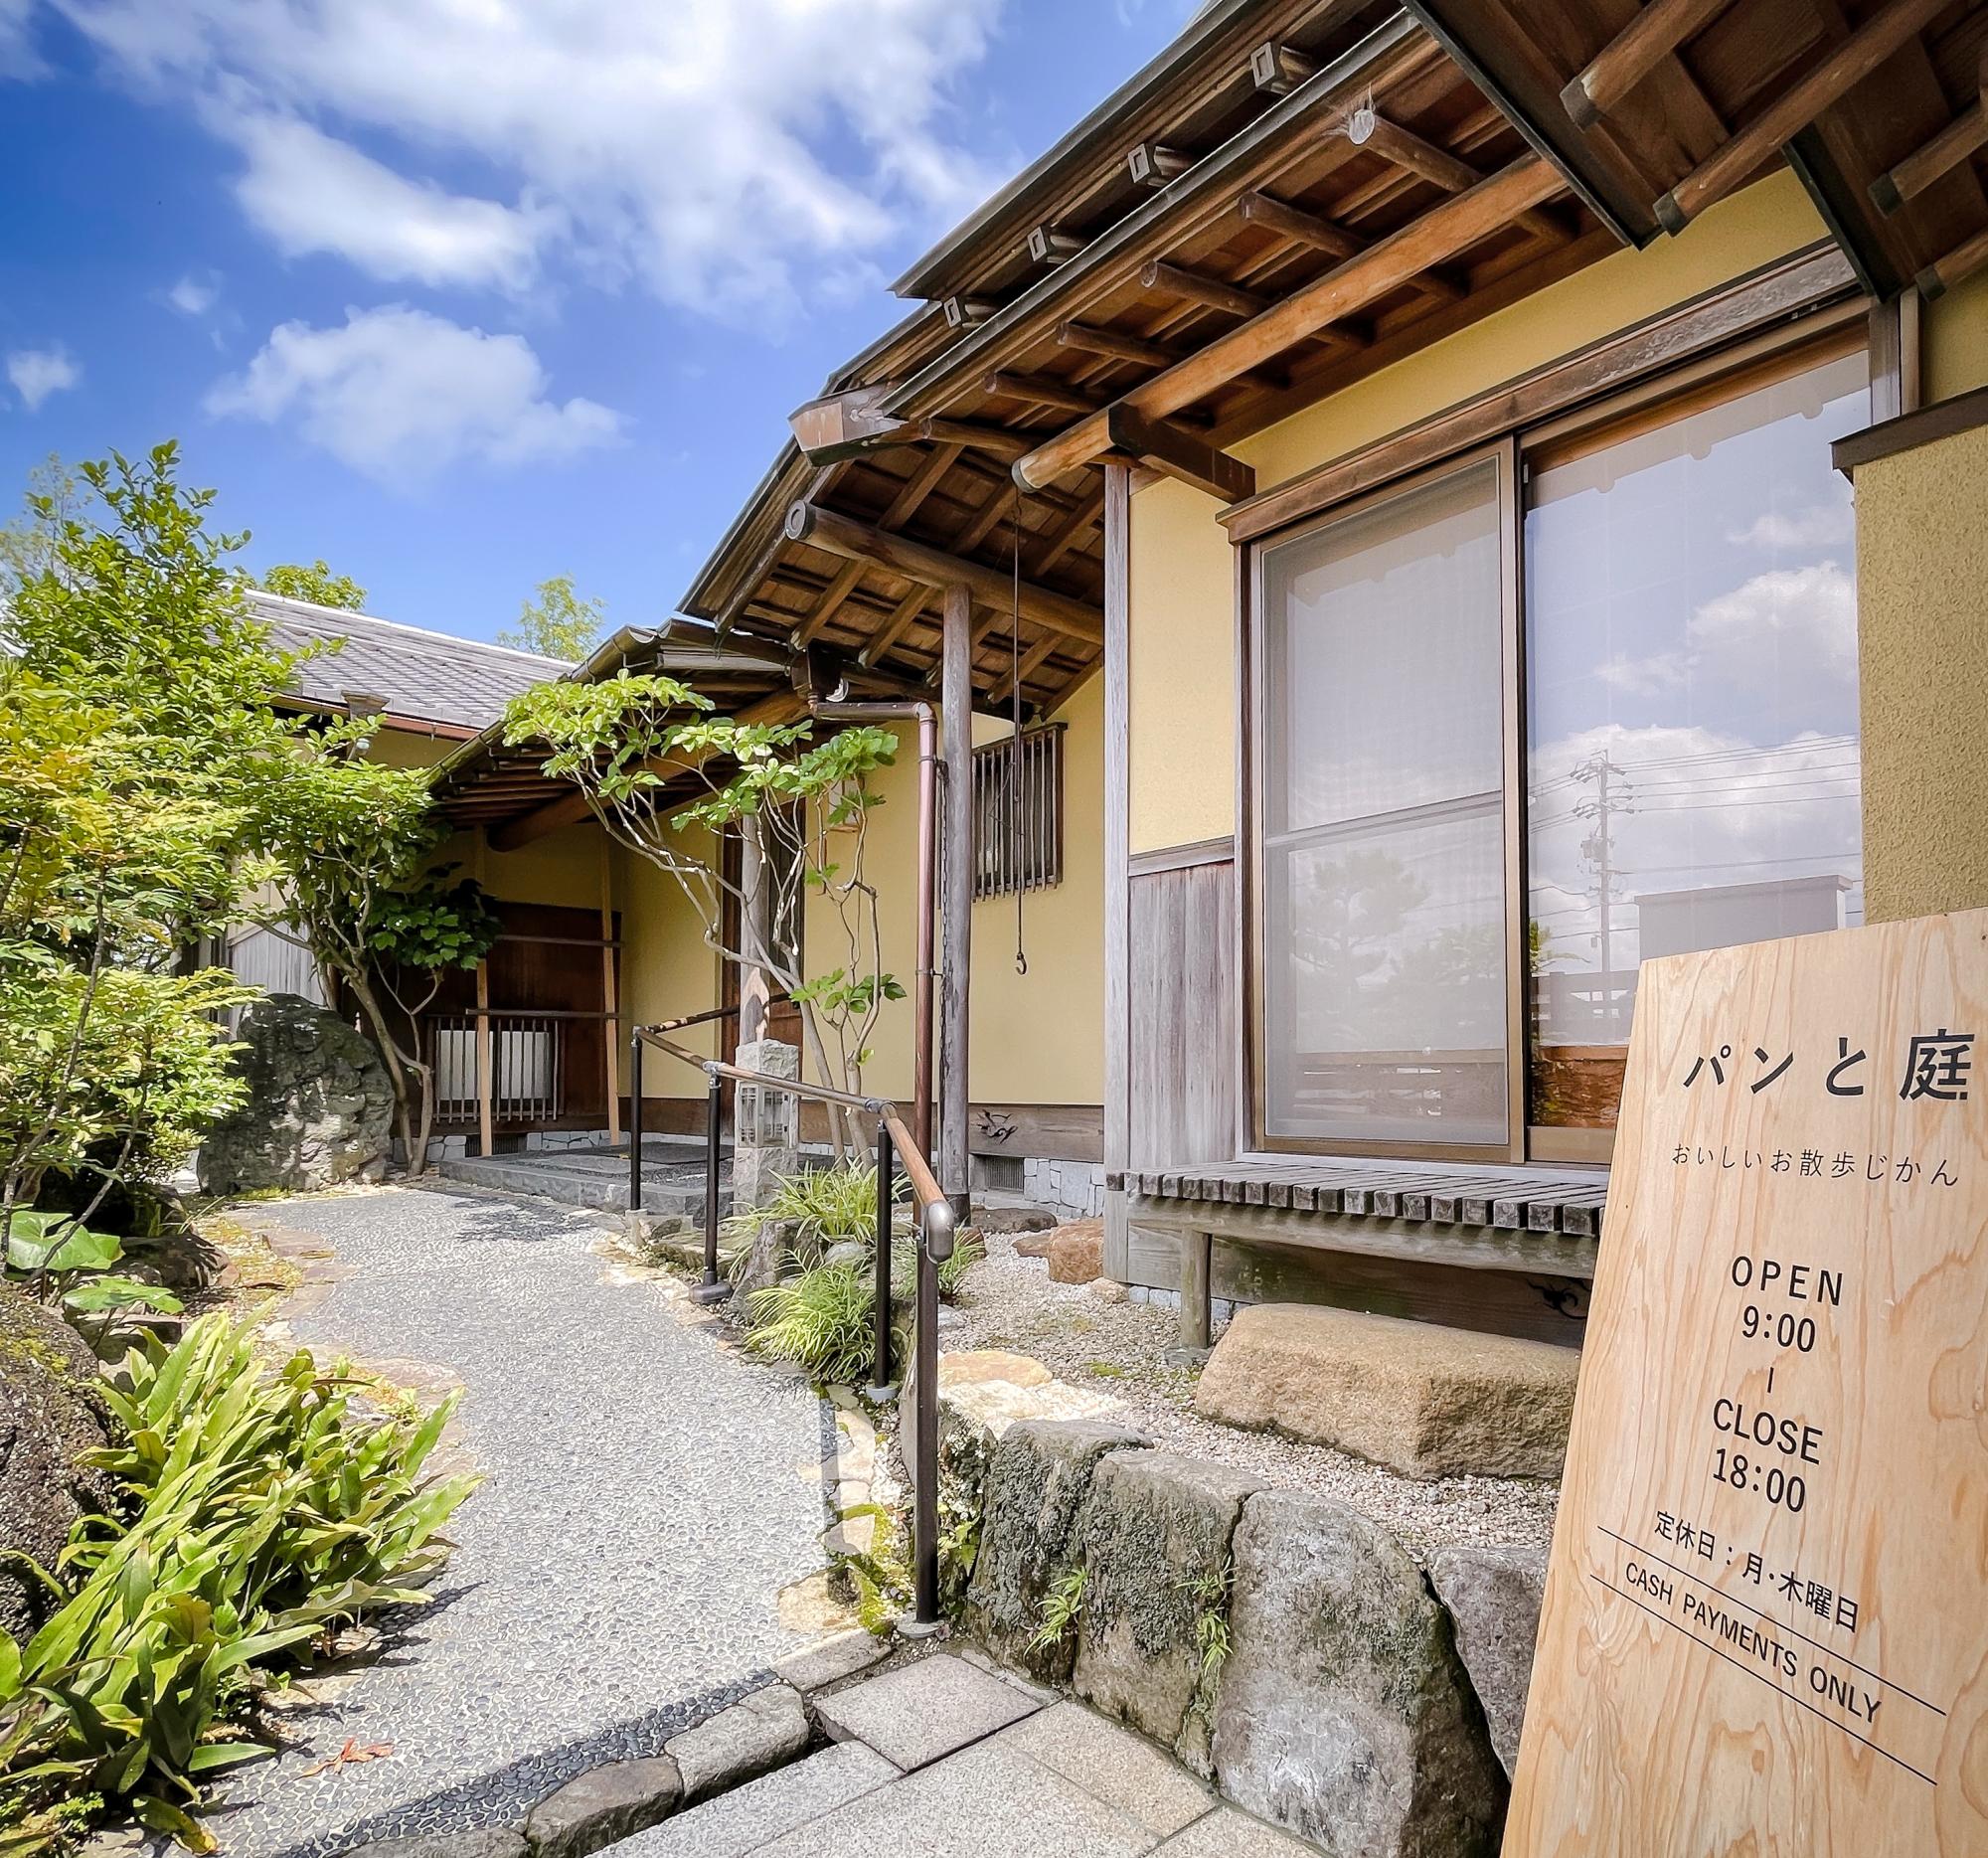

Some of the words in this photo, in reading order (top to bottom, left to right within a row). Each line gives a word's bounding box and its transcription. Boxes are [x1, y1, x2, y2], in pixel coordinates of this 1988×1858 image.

[1683, 1028, 1975, 1100] パンと庭
[1671, 1143, 1958, 1187] おいしいお散歩じかん
[1732, 1256, 1843, 1306] OPEN
[1741, 1305, 1816, 1353] 9:00
[1713, 1398, 1823, 1465] CLOSE
[1713, 1447, 1806, 1513] 18:00
[1625, 1562, 1673, 1605] CASH
[1683, 1593, 1798, 1677] PAYMENTS
[1809, 1666, 1883, 1724] ONLY
